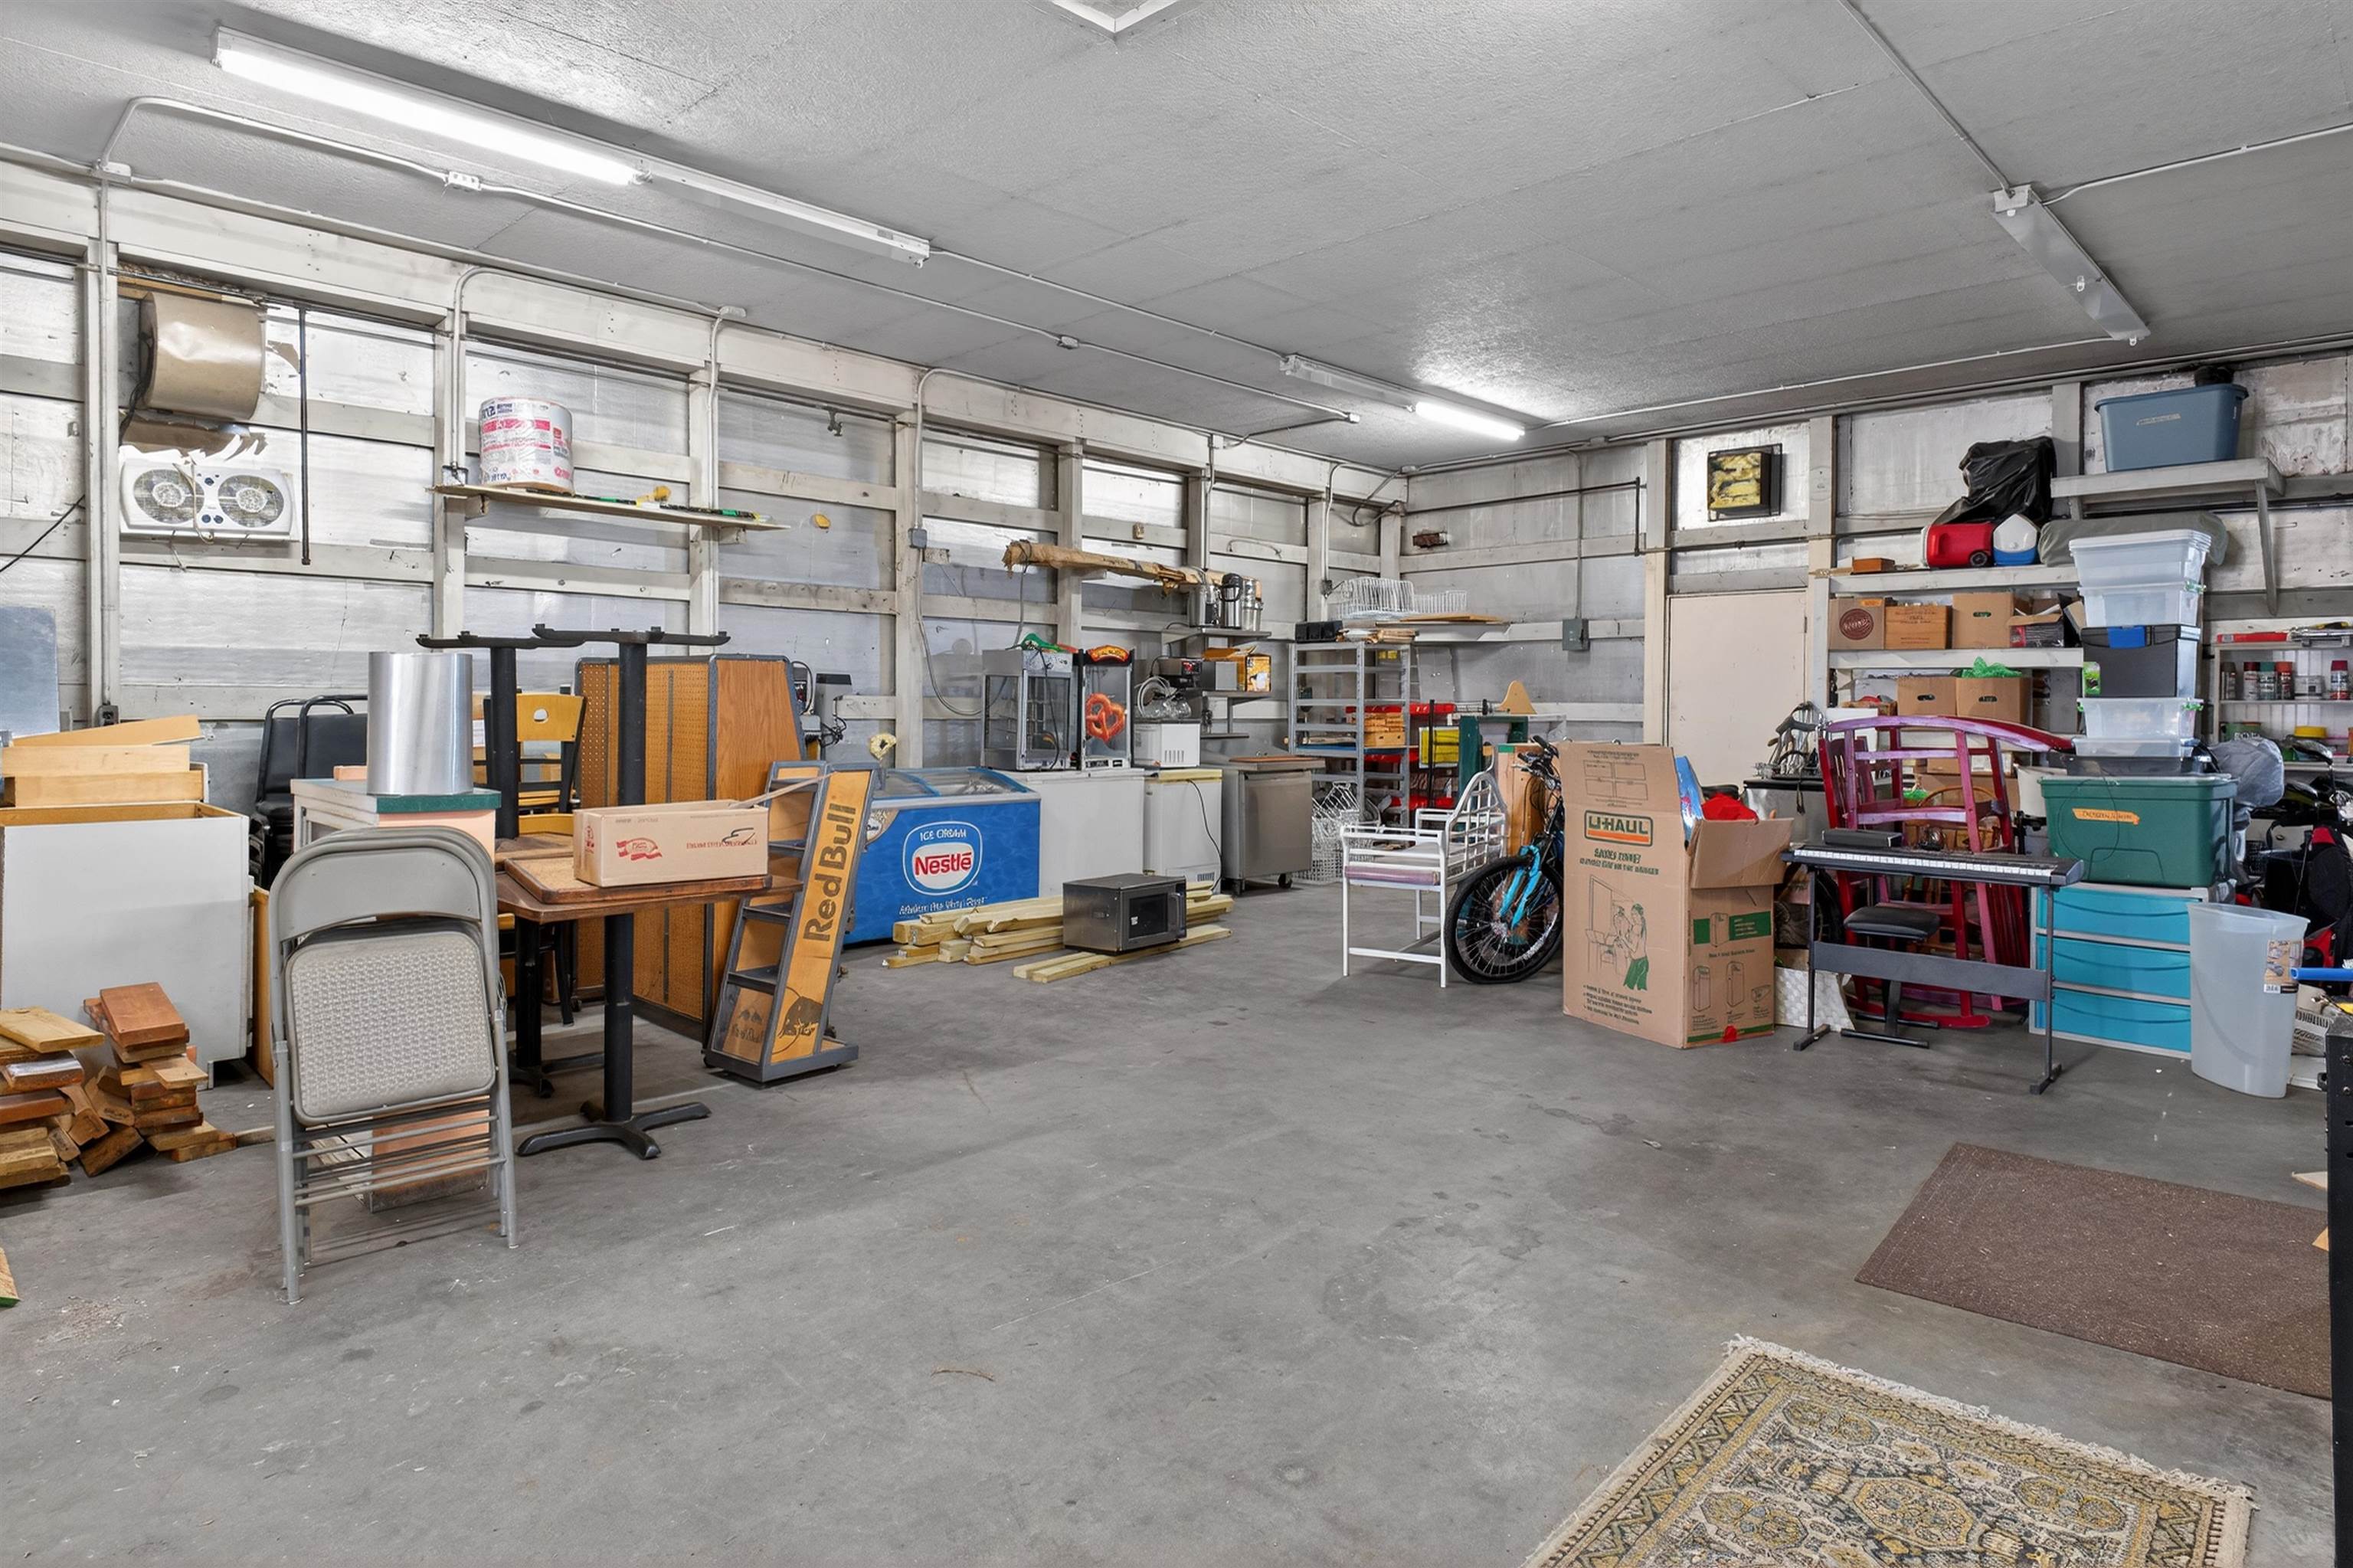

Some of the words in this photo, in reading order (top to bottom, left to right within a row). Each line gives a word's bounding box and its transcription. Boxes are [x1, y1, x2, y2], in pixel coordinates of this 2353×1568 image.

[818, 803, 856, 870] Bull
[920, 830, 934, 841] ICE
[1588, 816, 1649, 835] U-HAUL
[915, 852, 972, 876] Nestlé
[803, 873, 843, 941] Red
